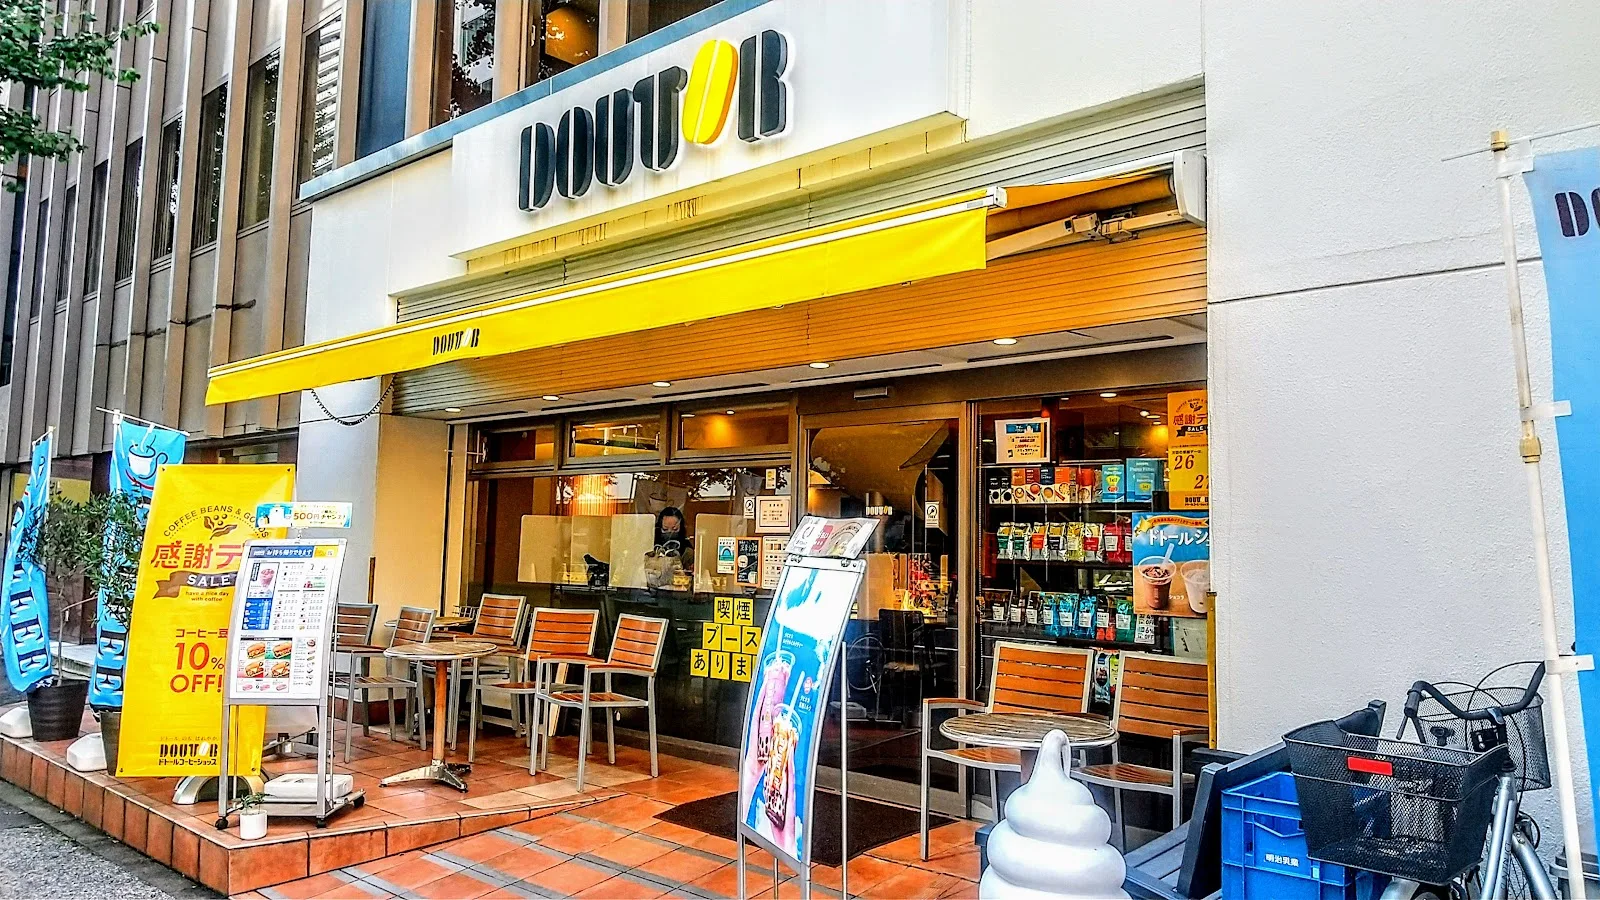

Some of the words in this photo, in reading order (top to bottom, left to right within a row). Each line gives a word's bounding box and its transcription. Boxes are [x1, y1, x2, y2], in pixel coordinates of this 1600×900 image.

[518, 29, 789, 213] DOUTOR
[1554, 187, 1600, 237] D
[432, 327, 480, 356] DOUTOR
[1173, 454, 1195, 470] 26
[163, 510, 197, 537] COFFEE
[200, 505, 233, 515] BEANS
[235, 508, 242, 516] &
[186, 574, 230, 587] SALE
[717, 599, 751, 620] 喫煙
[175, 628, 229, 638] コーヒー豆
[706, 625, 758, 647] ブース
[693, 651, 747, 676] ありま
[169, 674, 223, 693] OFF!
[159, 741, 219, 757] DOUTOR
